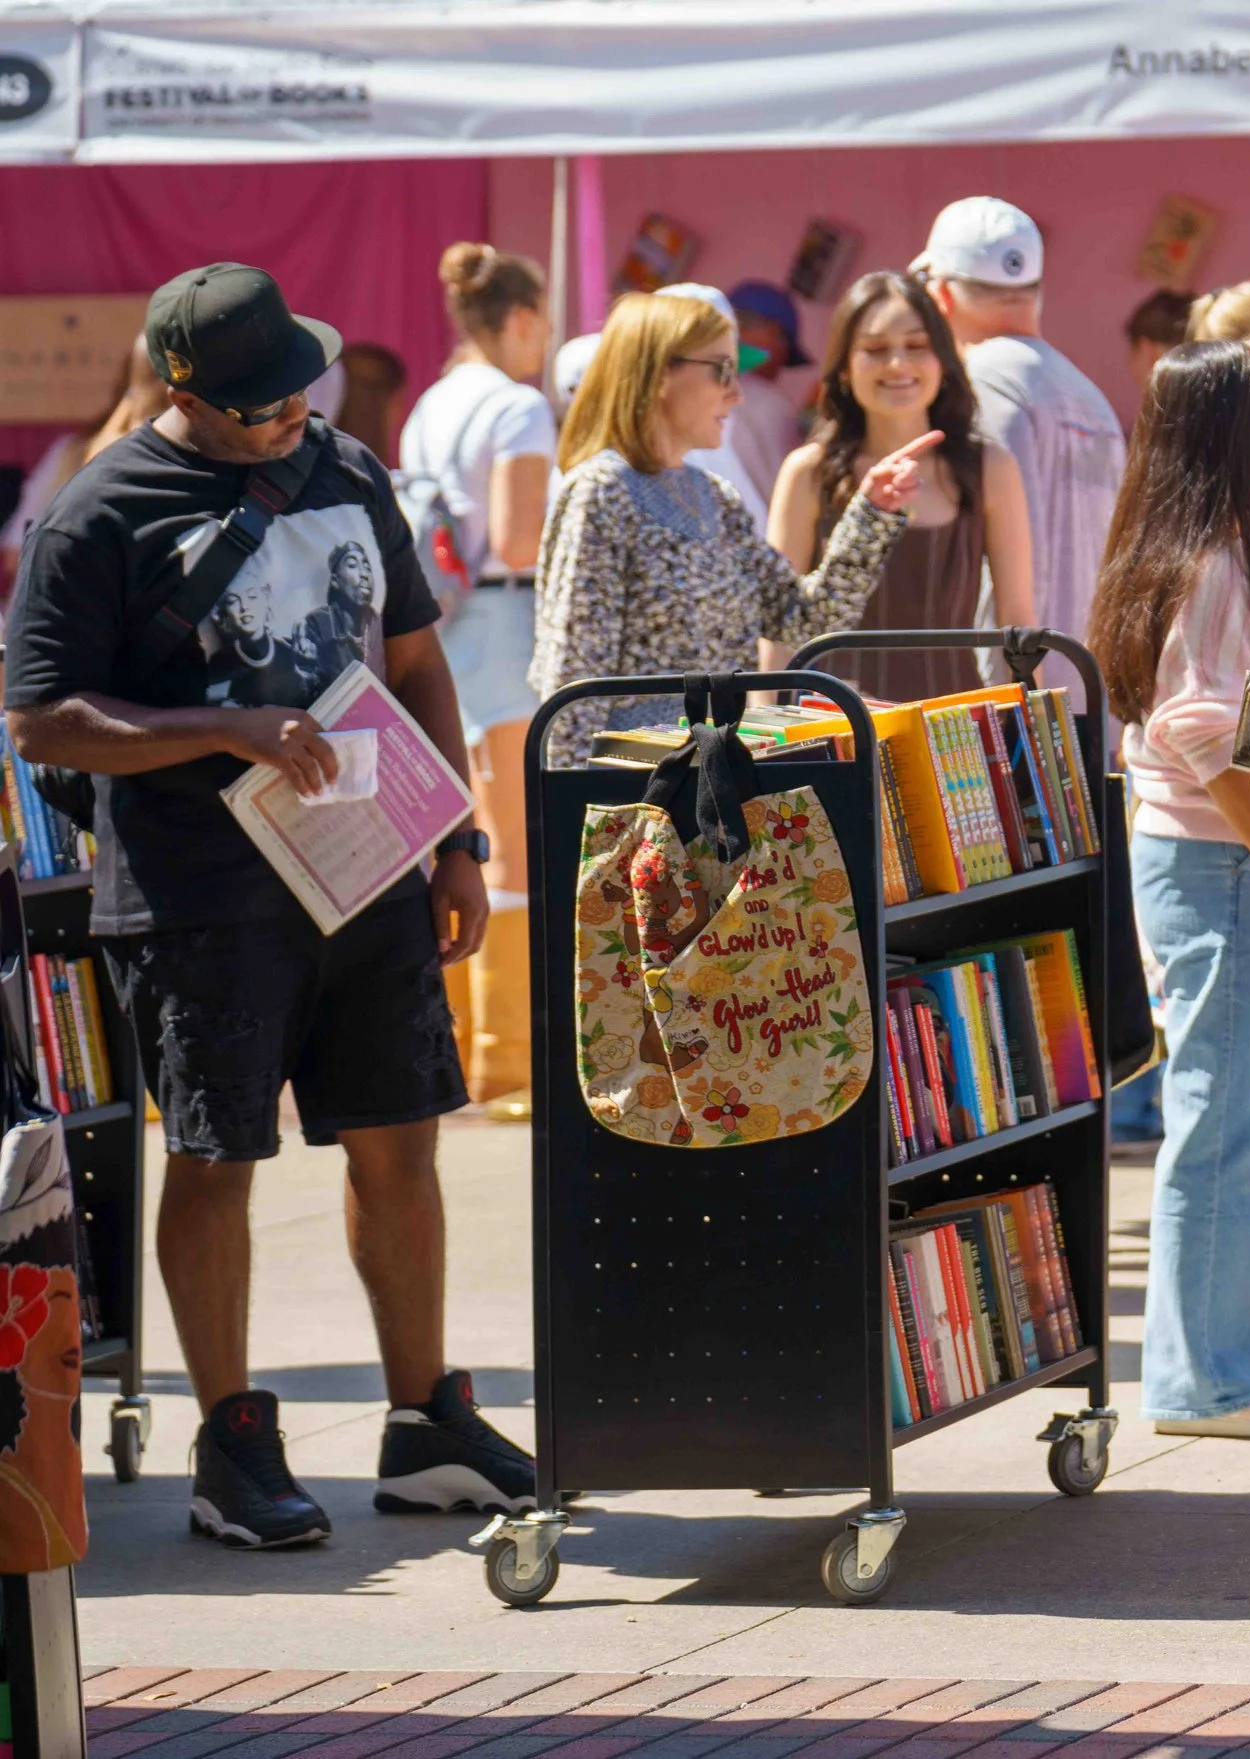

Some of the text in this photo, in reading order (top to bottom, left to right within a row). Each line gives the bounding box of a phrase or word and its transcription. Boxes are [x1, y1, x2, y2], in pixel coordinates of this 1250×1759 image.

[105, 82, 235, 110] FESTIVAL
[268, 82, 369, 105] BOOKS
[770, 911, 806, 952] up!
[712, 992, 771, 1055] Glow
[888, 1103, 902, 1147] THOMPSON
[969, 1243, 988, 1310] THE BIG SEA
